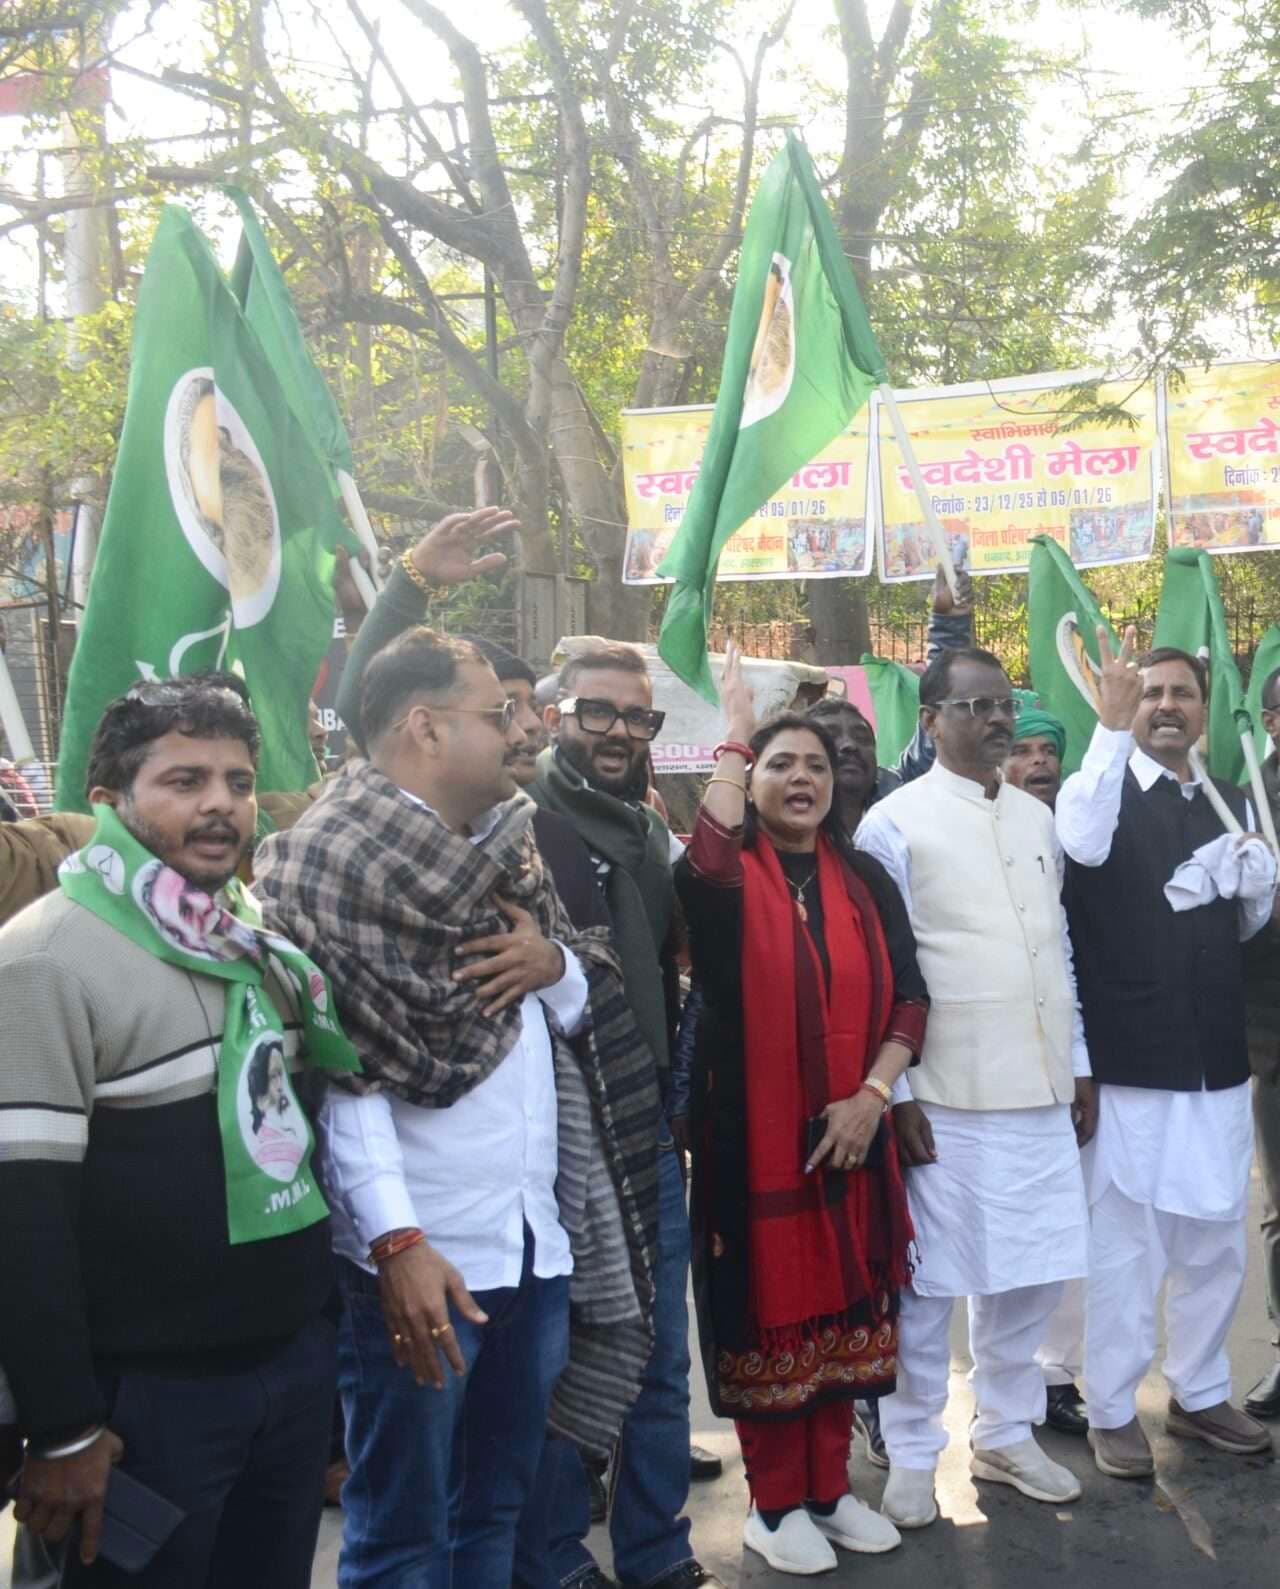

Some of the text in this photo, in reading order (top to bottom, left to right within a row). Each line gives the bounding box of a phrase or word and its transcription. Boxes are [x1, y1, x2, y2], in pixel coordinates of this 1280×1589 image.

[1047, 439, 1141, 477] मेला
[793, 462, 853, 489] ला
[975, 492, 1033, 513] 23/12/25
[1037, 487, 1047, 508] से
[1051, 487, 1112, 508] 05/01/26
